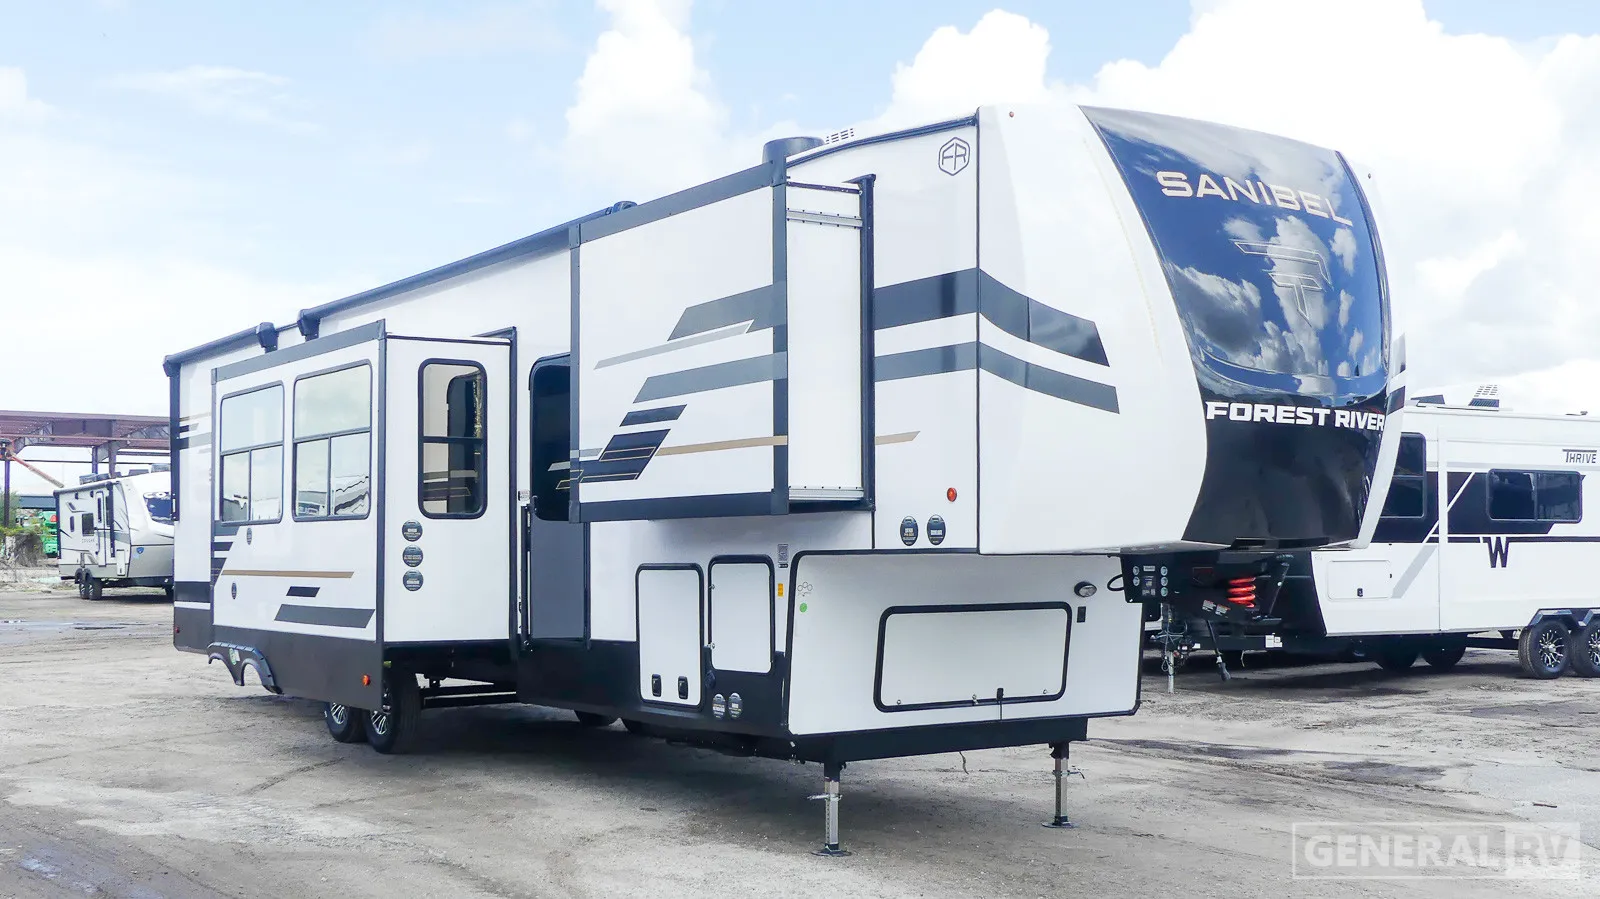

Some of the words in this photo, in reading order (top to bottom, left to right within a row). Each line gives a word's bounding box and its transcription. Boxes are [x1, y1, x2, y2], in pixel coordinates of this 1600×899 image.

[1156, 170, 1353, 226] SANIBEL
[1206, 401, 1330, 426] FOREST
[1334, 409, 1385, 431] RIVER
